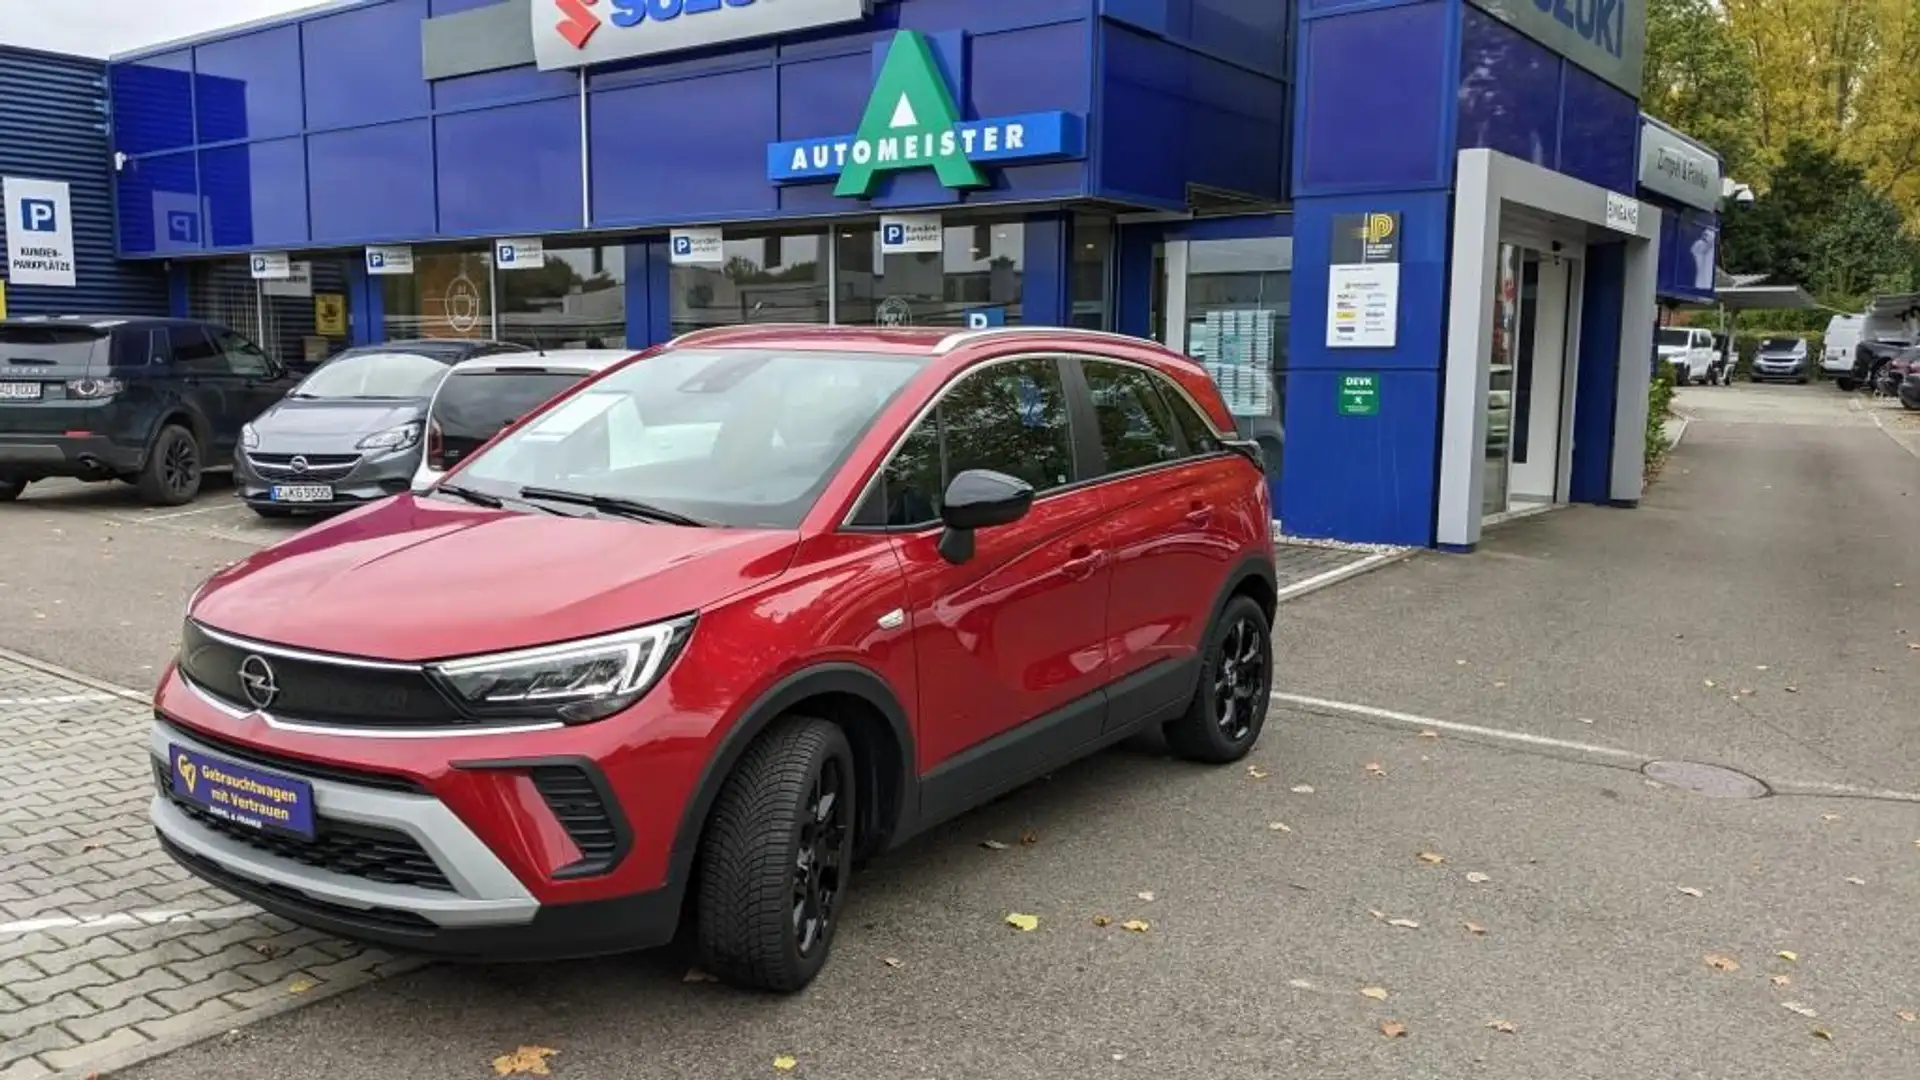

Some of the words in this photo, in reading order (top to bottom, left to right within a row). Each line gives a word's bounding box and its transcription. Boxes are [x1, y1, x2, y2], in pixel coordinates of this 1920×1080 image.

[791, 122, 1025, 171] AUTOMEISTER
[1608, 200, 1637, 225] EINGANG
[13, 258, 71, 272] PARKPLÄTZE
[20, 246, 62, 258] KUNDEN-
[201, 764, 298, 804] Gebrauchtwagen
[211, 788, 229, 805] mit
[230, 793, 290, 821] Vertrauen
